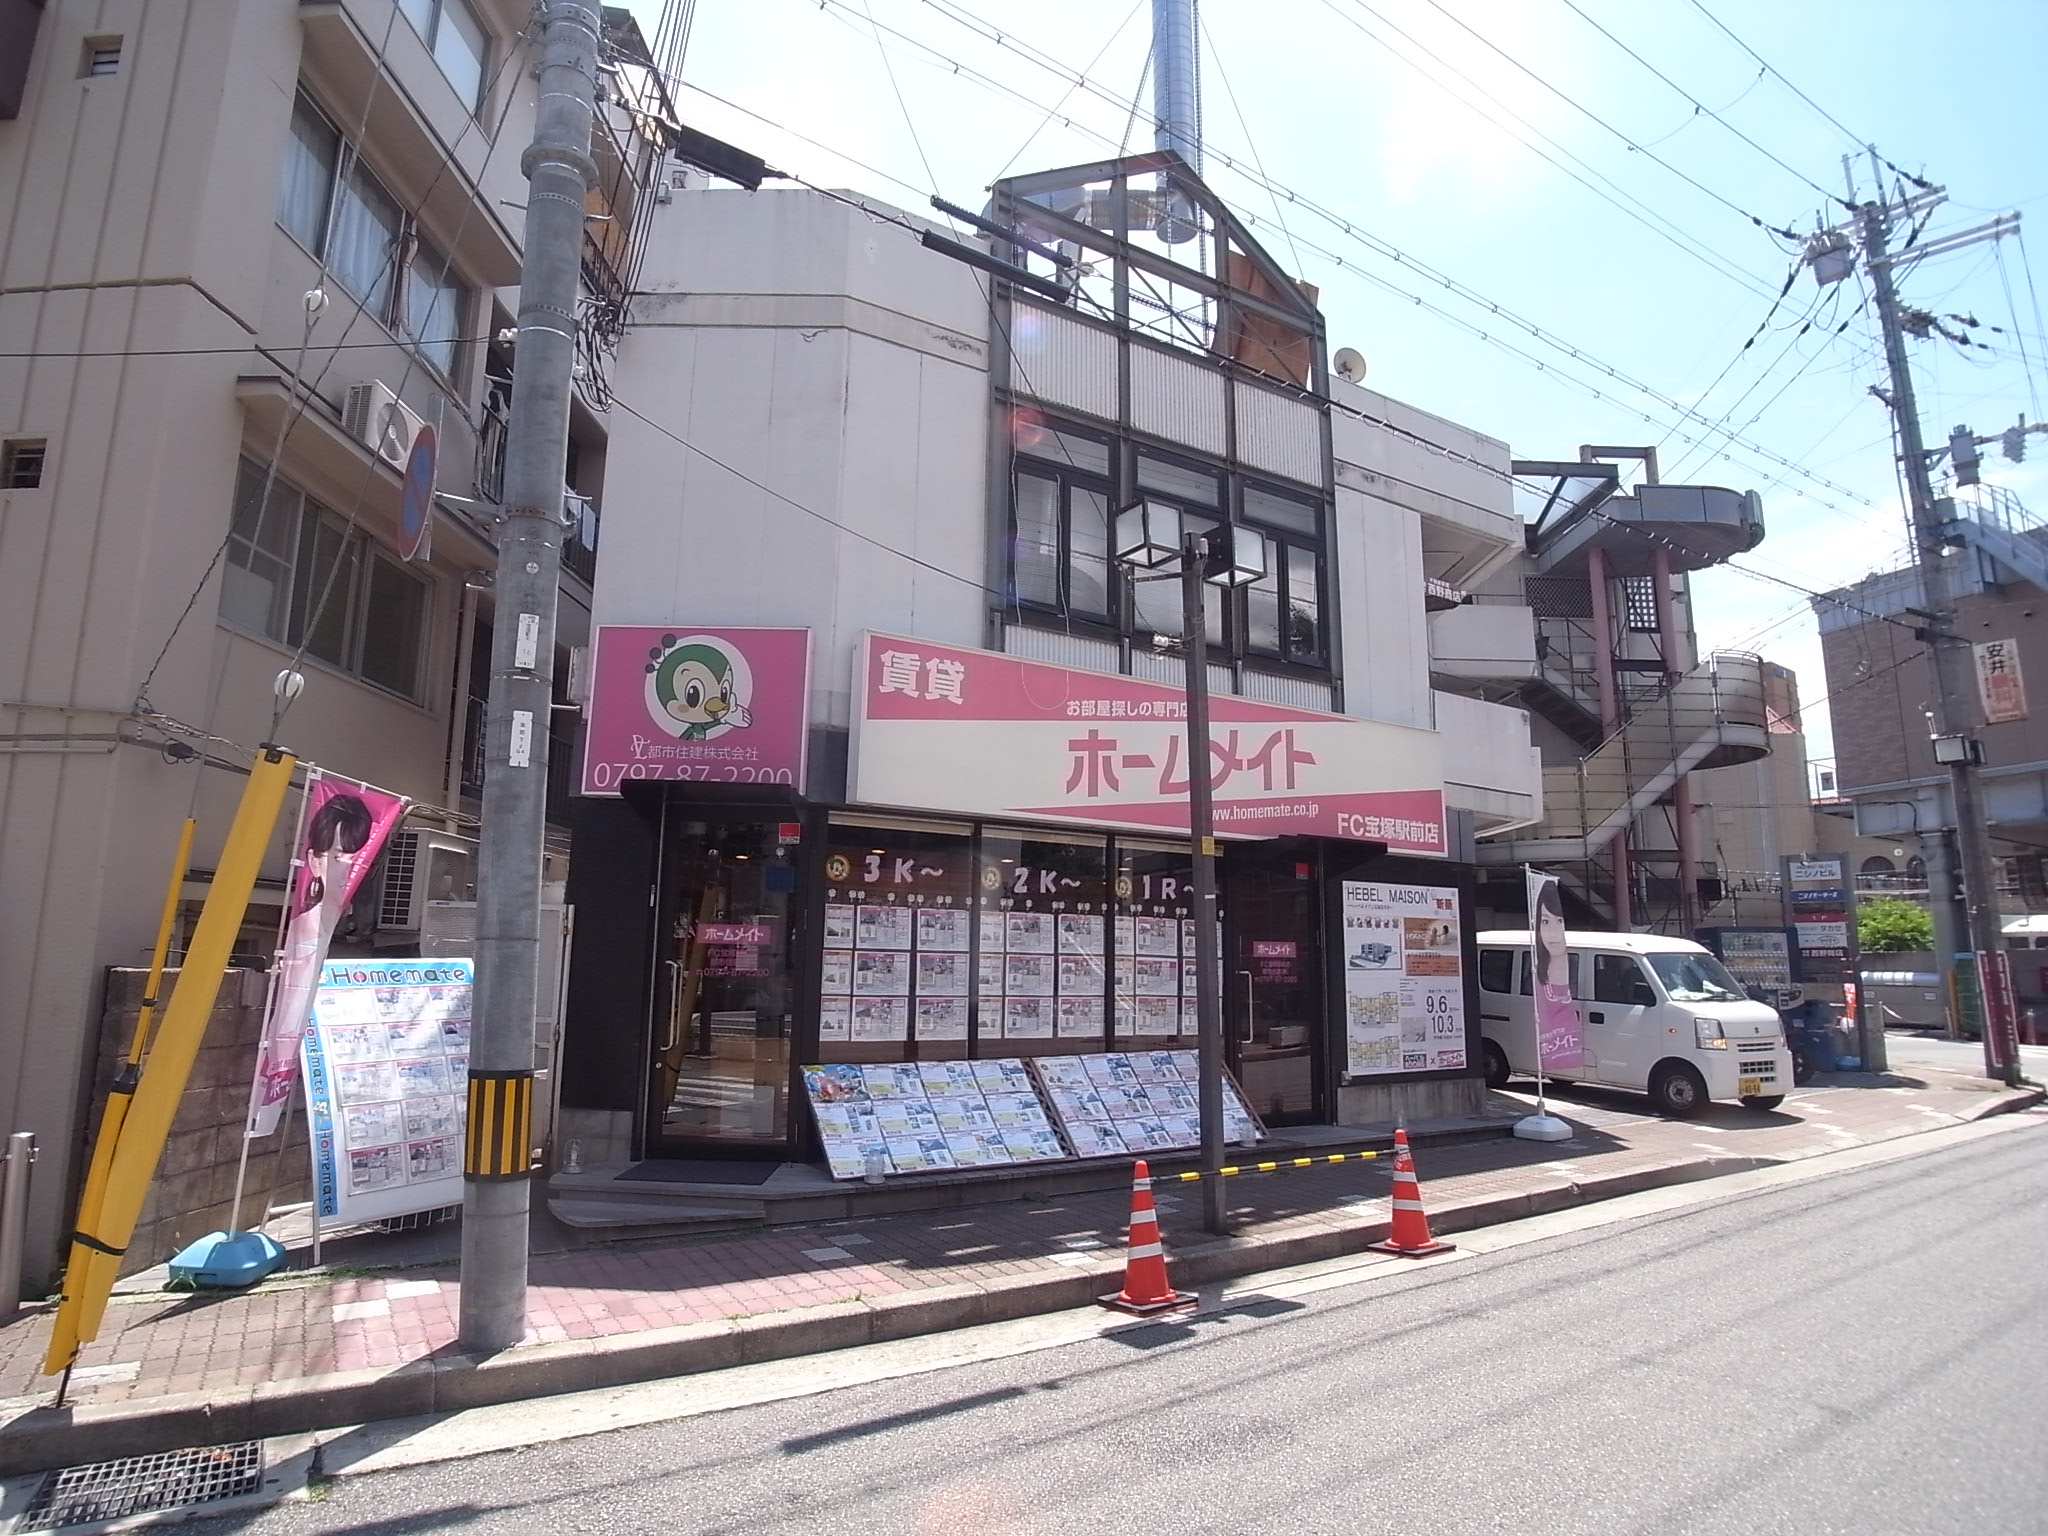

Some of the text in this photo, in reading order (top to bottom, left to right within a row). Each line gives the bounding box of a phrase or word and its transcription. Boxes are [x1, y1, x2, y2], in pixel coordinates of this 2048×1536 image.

[878, 649, 965, 705] 賃貸
[647, 745, 759, 761] 都市住建株式会社
[1065, 728, 1316, 798] ホームメイト
[594, 763, 793, 787] 0797-87-2200
[1212, 801, 1319, 821] ww.homemate.co.jp
[1337, 812, 1439, 844] FC宝塚駅前店
[1346, 886, 1429, 905] HEBEL MAISON
[704, 927, 763, 942] ホームメイト
[331, 966, 466, 986] Homemate
[1426, 995, 1448, 1014] 9.6
[1431, 1014, 1454, 1034] 10.3
[306, 1017, 325, 1096] Homemate
[318, 1127, 333, 1216] Homemate
